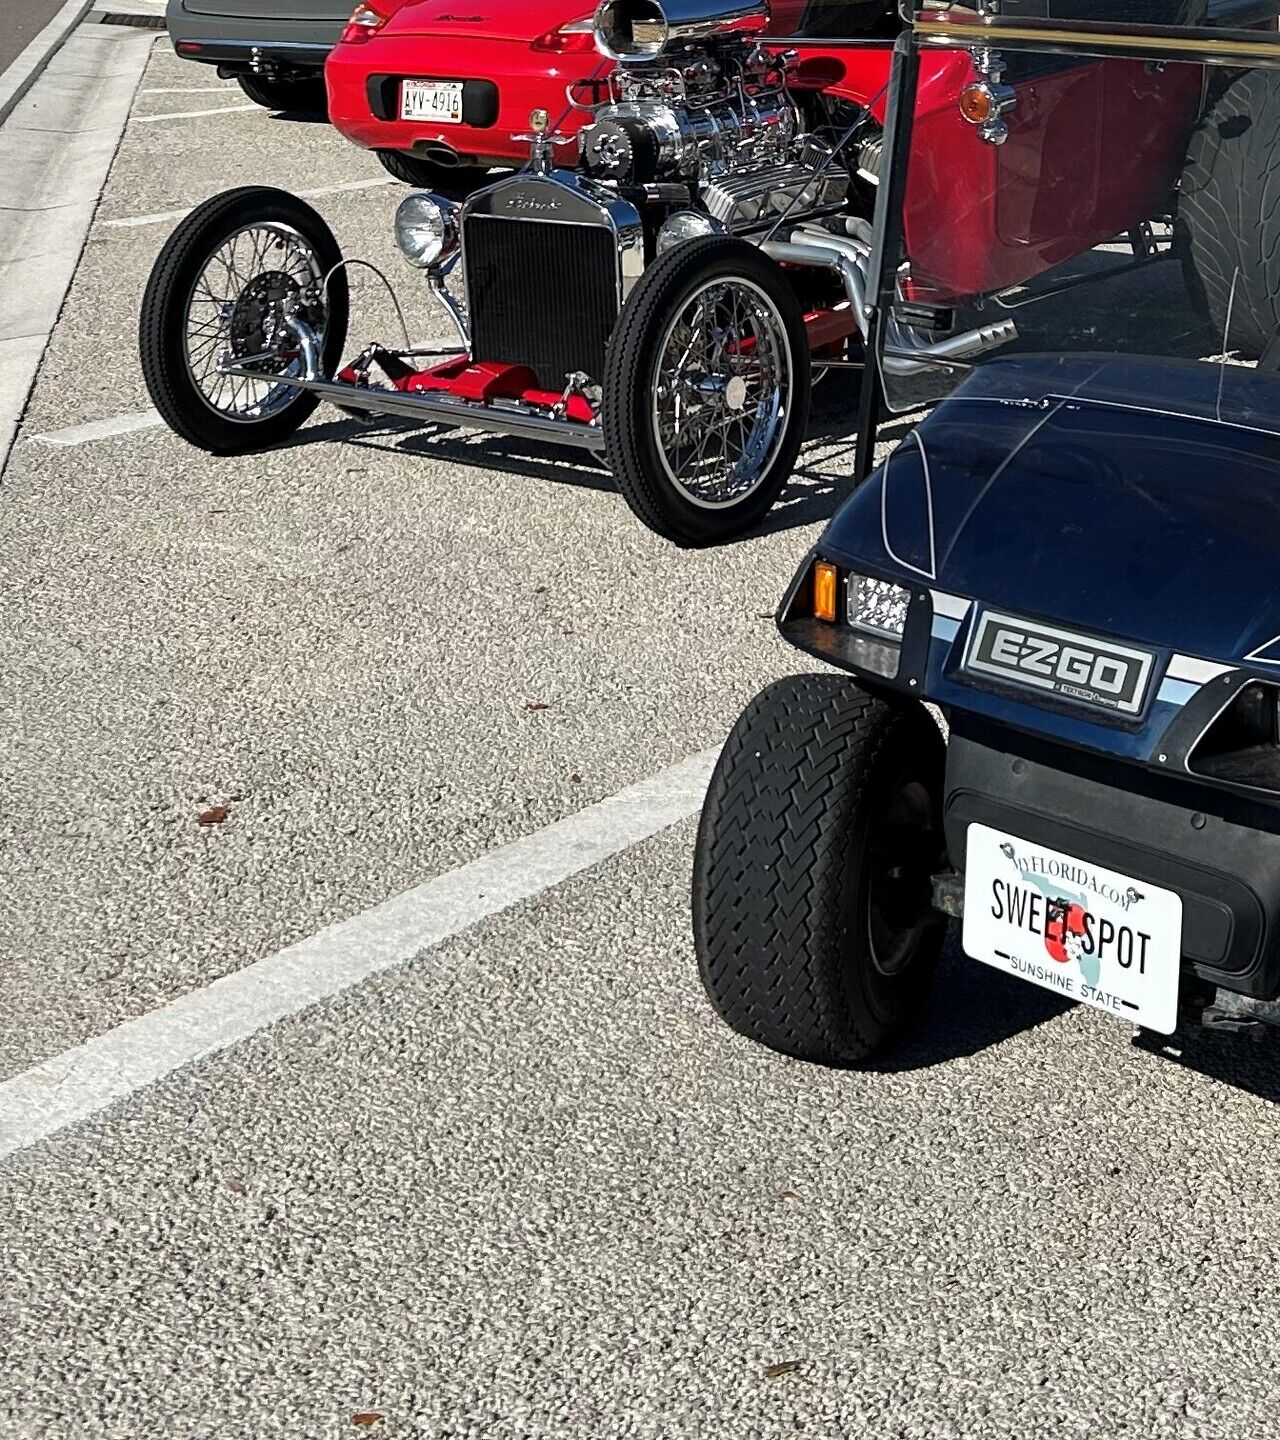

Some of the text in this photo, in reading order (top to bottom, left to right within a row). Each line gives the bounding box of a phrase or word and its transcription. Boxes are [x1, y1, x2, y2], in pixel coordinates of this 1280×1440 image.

[404, 90, 459, 112] AYV-4916
[991, 878, 1151, 975] SWEET SPOT
[1010, 956, 1122, 1011] SUNSHINE STATE
